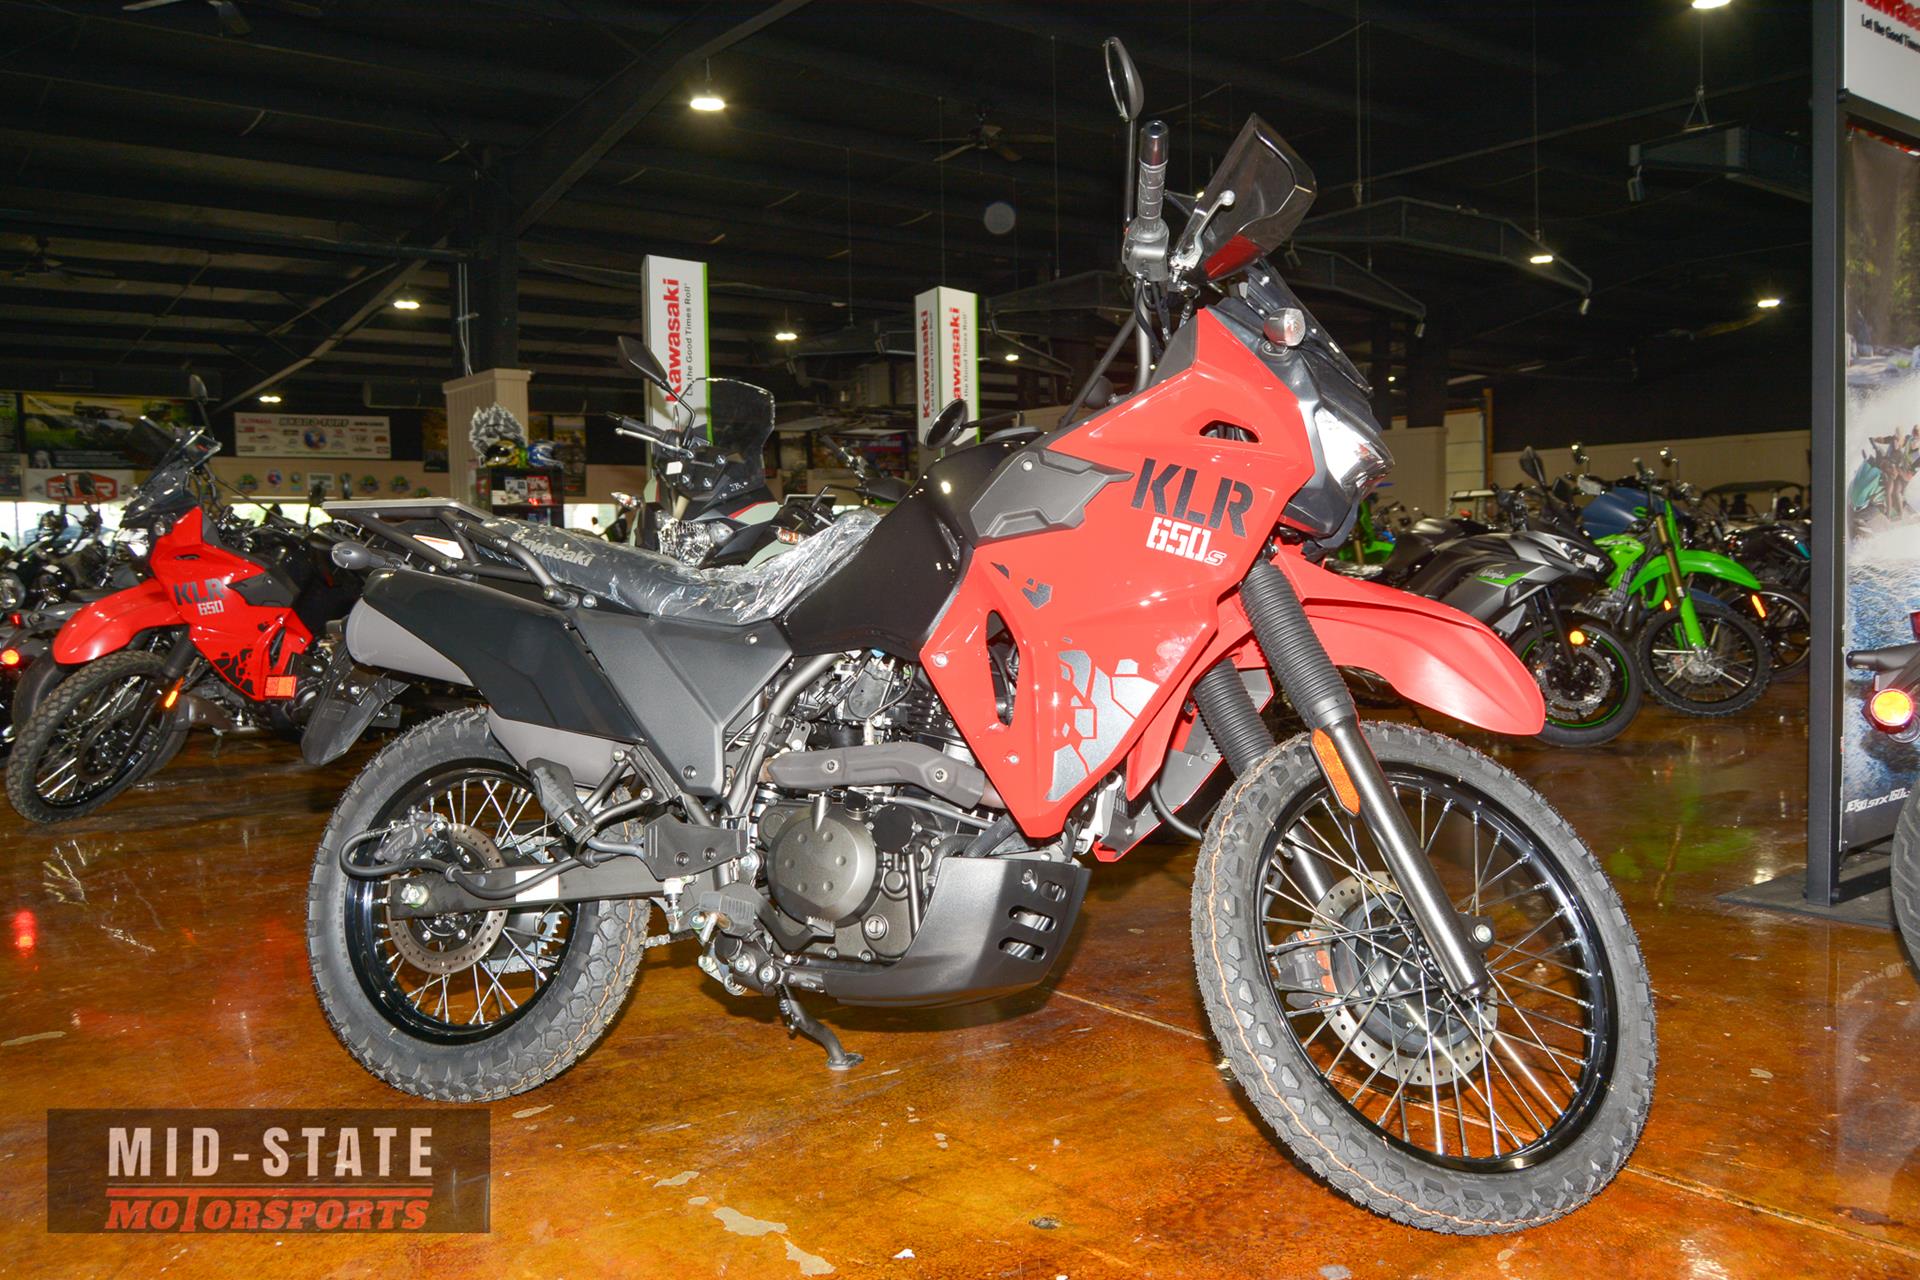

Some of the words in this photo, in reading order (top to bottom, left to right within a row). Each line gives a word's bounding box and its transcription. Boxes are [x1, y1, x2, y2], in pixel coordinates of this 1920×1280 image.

[921, 309, 931, 418] Kawasaki
[949, 307, 962, 399] awasaki
[1131, 458, 1254, 538] KLR
[173, 578, 224, 606] KLR
[197, 600, 225, 616] 650
